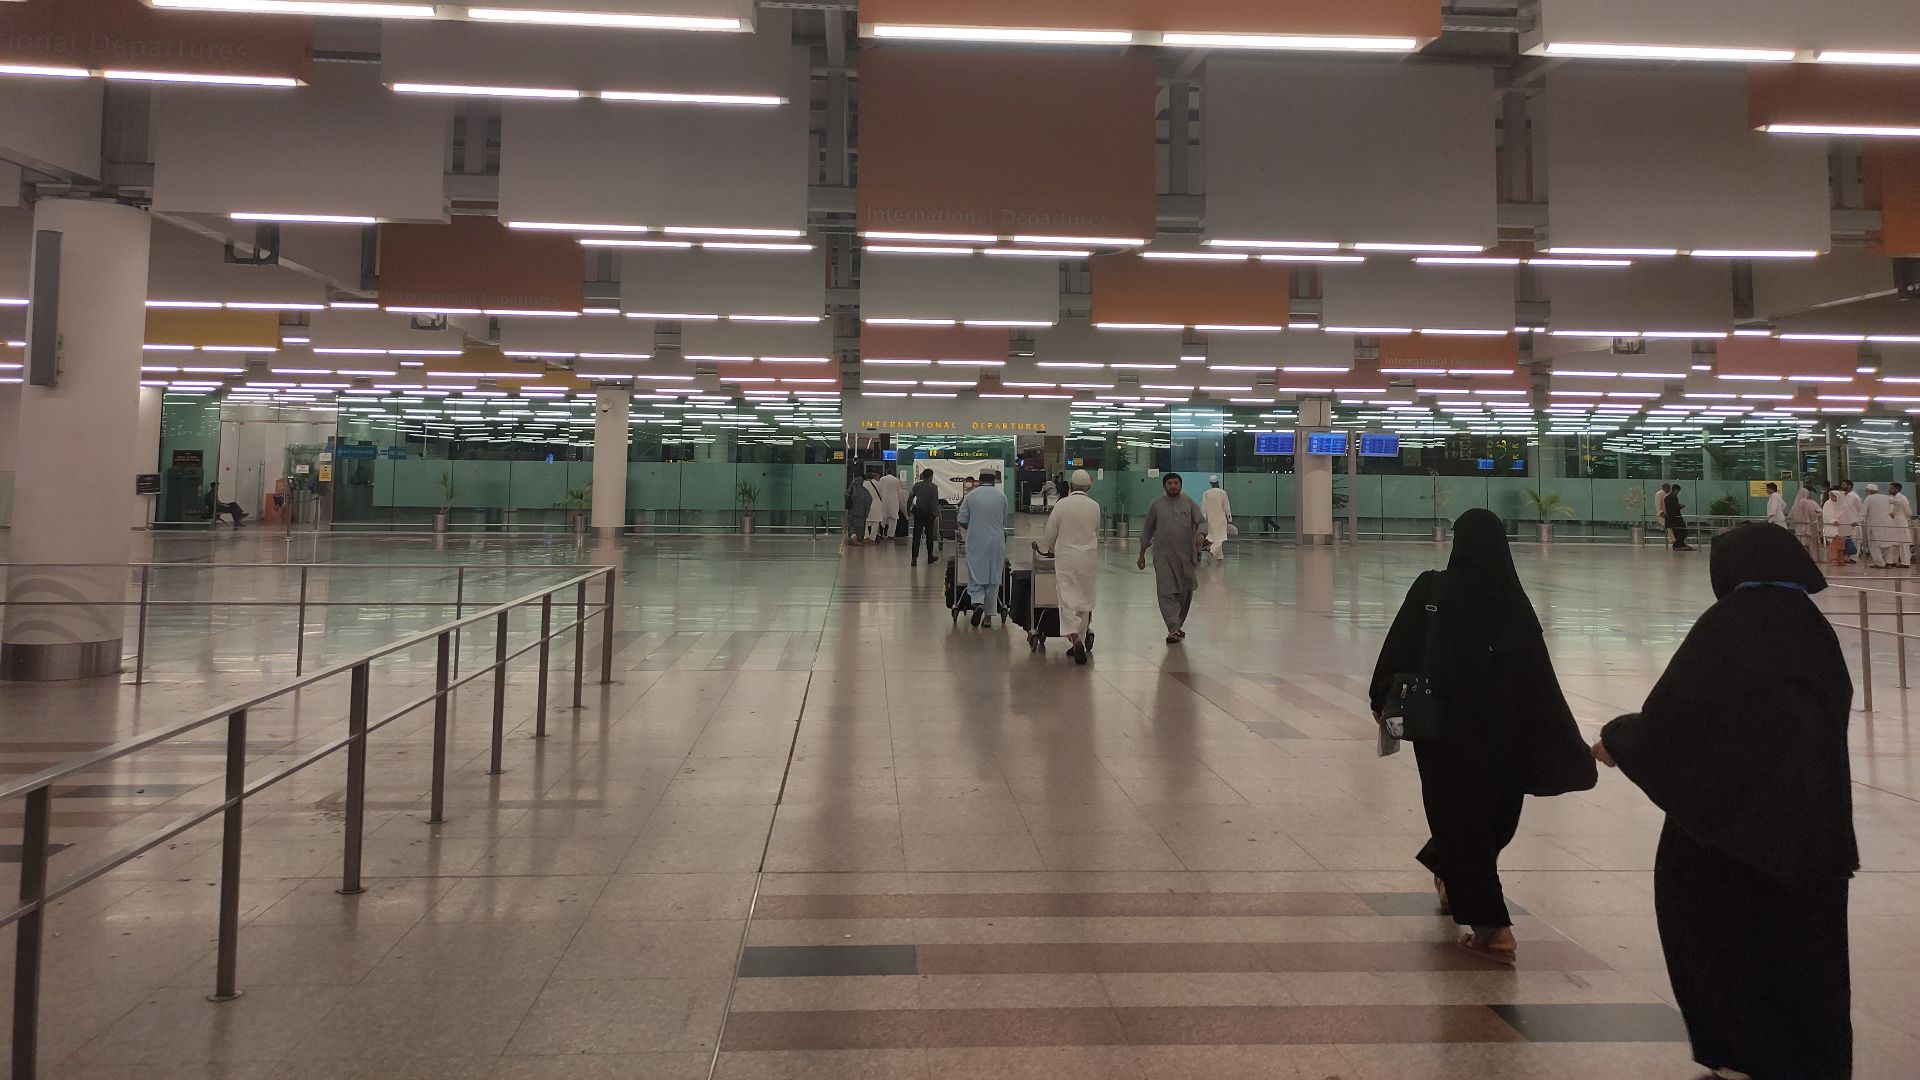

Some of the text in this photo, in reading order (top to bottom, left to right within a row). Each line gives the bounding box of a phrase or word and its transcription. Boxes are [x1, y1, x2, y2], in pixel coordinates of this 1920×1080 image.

[90, 32, 248, 60] Departures
[867, 206, 1111, 228] International Departures
[386, 289, 559, 306] International Departures
[1385, 356, 1447, 366] International
[861, 420, 1046, 430] INTERNATIONAL DEPARTURES
